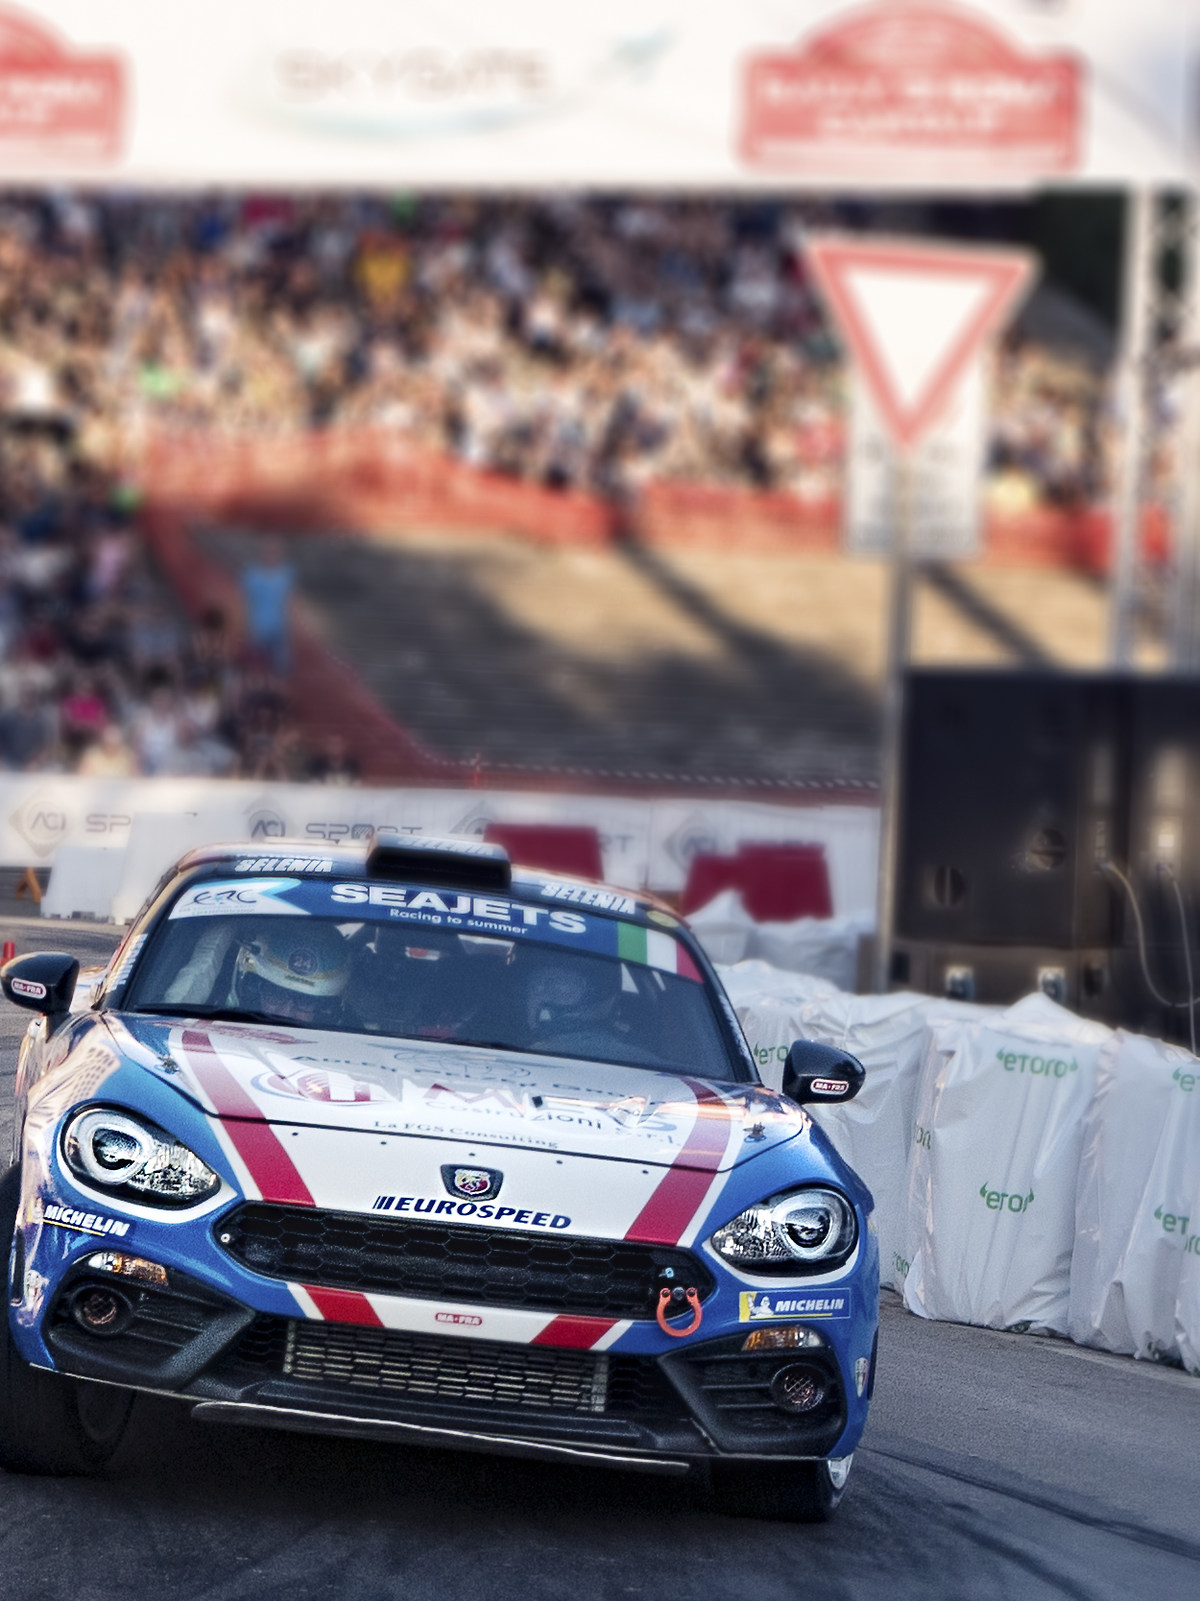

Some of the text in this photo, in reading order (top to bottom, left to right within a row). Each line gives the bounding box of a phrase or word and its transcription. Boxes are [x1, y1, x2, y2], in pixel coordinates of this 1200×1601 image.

[234, 857, 334, 873] SELENIA
[330, 883, 587, 934] SEAJETS
[540, 881, 637, 915] SELENIA
[390, 908, 529, 935] Racing to summer
[449, 1126, 558, 1149] Consulting
[44, 1204, 131, 1237] MICHELIN
[394, 1197, 572, 1229] EUROSPEED
[774, 1298, 845, 1312] MICHELIN
